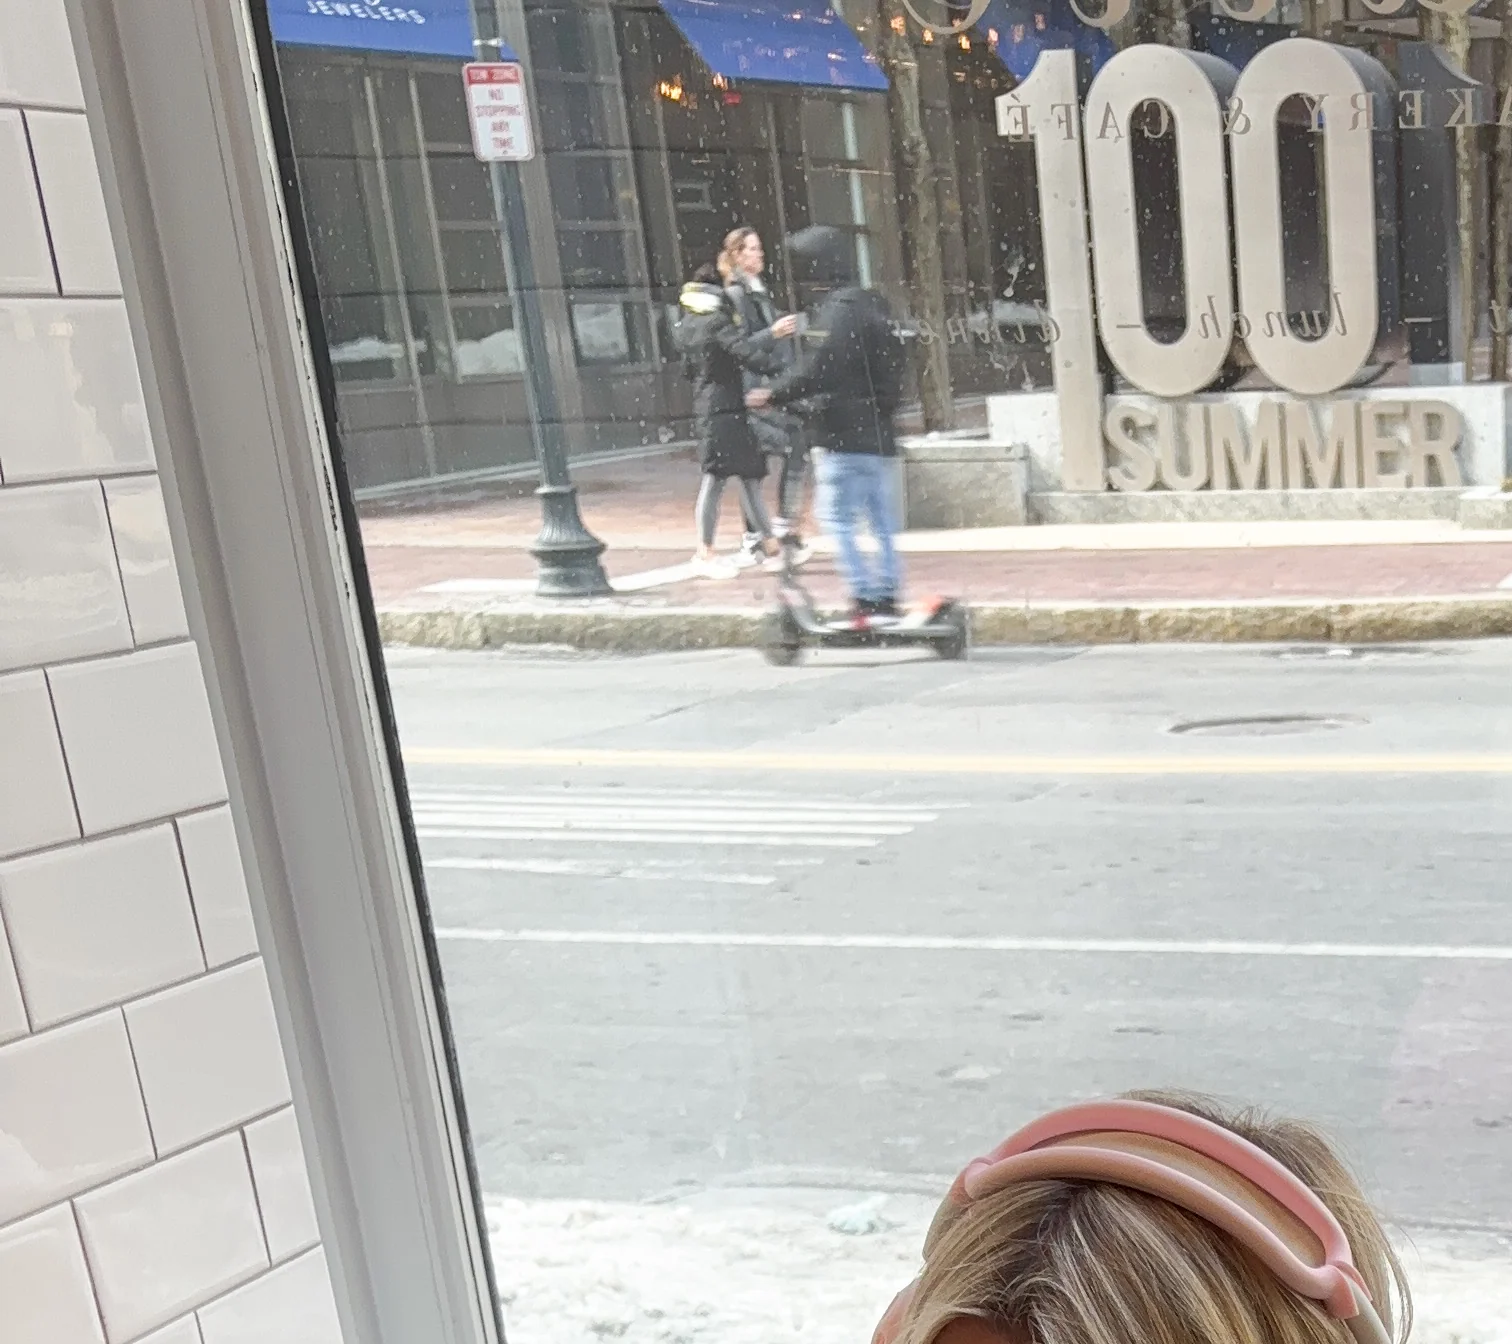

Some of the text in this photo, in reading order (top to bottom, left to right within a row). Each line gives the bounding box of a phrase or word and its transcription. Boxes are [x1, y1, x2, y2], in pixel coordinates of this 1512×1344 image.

[306, 0, 426, 24] JEWELERS
[995, 37, 1382, 491] 100
[1104, 399, 1468, 491] SUMMER
